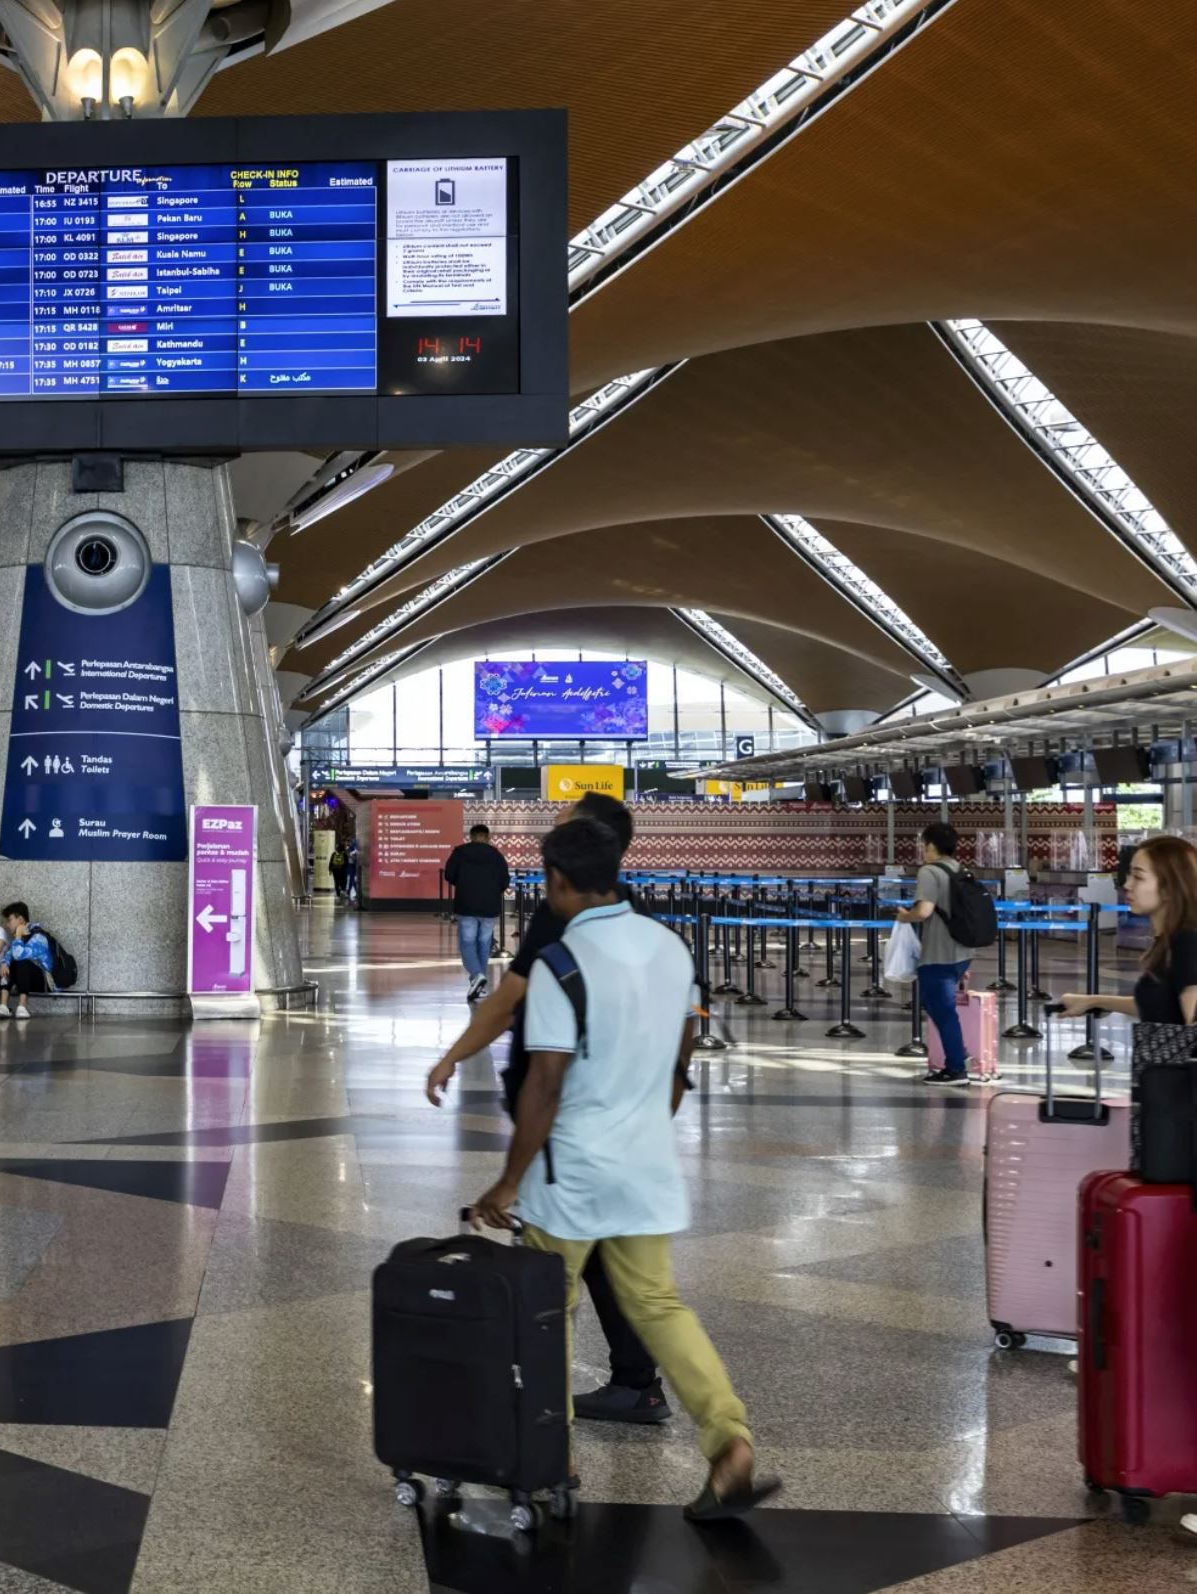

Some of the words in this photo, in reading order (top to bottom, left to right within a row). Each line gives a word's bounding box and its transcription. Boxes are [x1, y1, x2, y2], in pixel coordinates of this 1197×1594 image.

[46, 170, 142, 183] DEPARTURE
[231, 171, 274, 179] CHECK-IN
[277, 170, 298, 178] INFO
[35, 185, 55, 193] Time
[64, 184, 88, 193] Flight
[157, 182, 167, 190] To
[233, 180, 252, 188] Row
[270, 179, 297, 187] Status
[330, 178, 372, 187] Estimated
[35, 200, 56, 208] 16:55
[78, 198, 98, 206] 3415
[157, 197, 198, 206] Singapore
[157, 214, 181, 222] Pekan
[184, 214, 202, 222] Baru
[34, 235, 57, 243] 17:00
[76, 233, 95, 241] 4091
[157, 232, 198, 241] Singapore
[34, 253, 56, 261] 17:00
[78, 252, 98, 260] 0322
[157, 250, 179, 258] Kuala
[182, 250, 206, 258] Namu
[35, 271, 56, 279] 17:00
[78, 270, 98, 278] 0723
[157, 267, 220, 276] Istanbul-Sabiha
[34, 289, 56, 297] 17:10
[75, 288, 95, 296] 0726
[157, 287, 181, 296] Taipei
[269, 283, 292, 291] BUKA
[157, 304, 192, 312] Amritsar
[35, 325, 56, 333] 17:15
[157, 322, 173, 330] Miri
[35, 343, 56, 351] 17:30
[157, 340, 203, 348] Kathmandu
[64, 360, 78, 368] MH
[156, 358, 202, 367] Yogyakarta
[35, 378, 56, 386] 17:35
[81, 660, 122, 669] Perlepasan
[81, 670, 127, 678] International
[128, 671, 167, 681] Departures
[80, 692, 121, 701] Perlepasan
[123, 693, 148, 701] Dalam
[149, 695, 174, 705] Negeri
[115, 702, 154, 712] Departures
[739, 740, 753, 756] G
[81, 755, 112, 764] Tandas
[81, 766, 110, 774] Toilets
[575, 781, 594, 790] Sun
[595, 779, 613, 790] Life
[79, 819, 106, 827] Surau
[202, 819, 243, 830] EZPaz
[78, 829, 110, 838] Muslim
[112, 830, 141, 840] Prayer
[142, 831, 167, 840] Room
